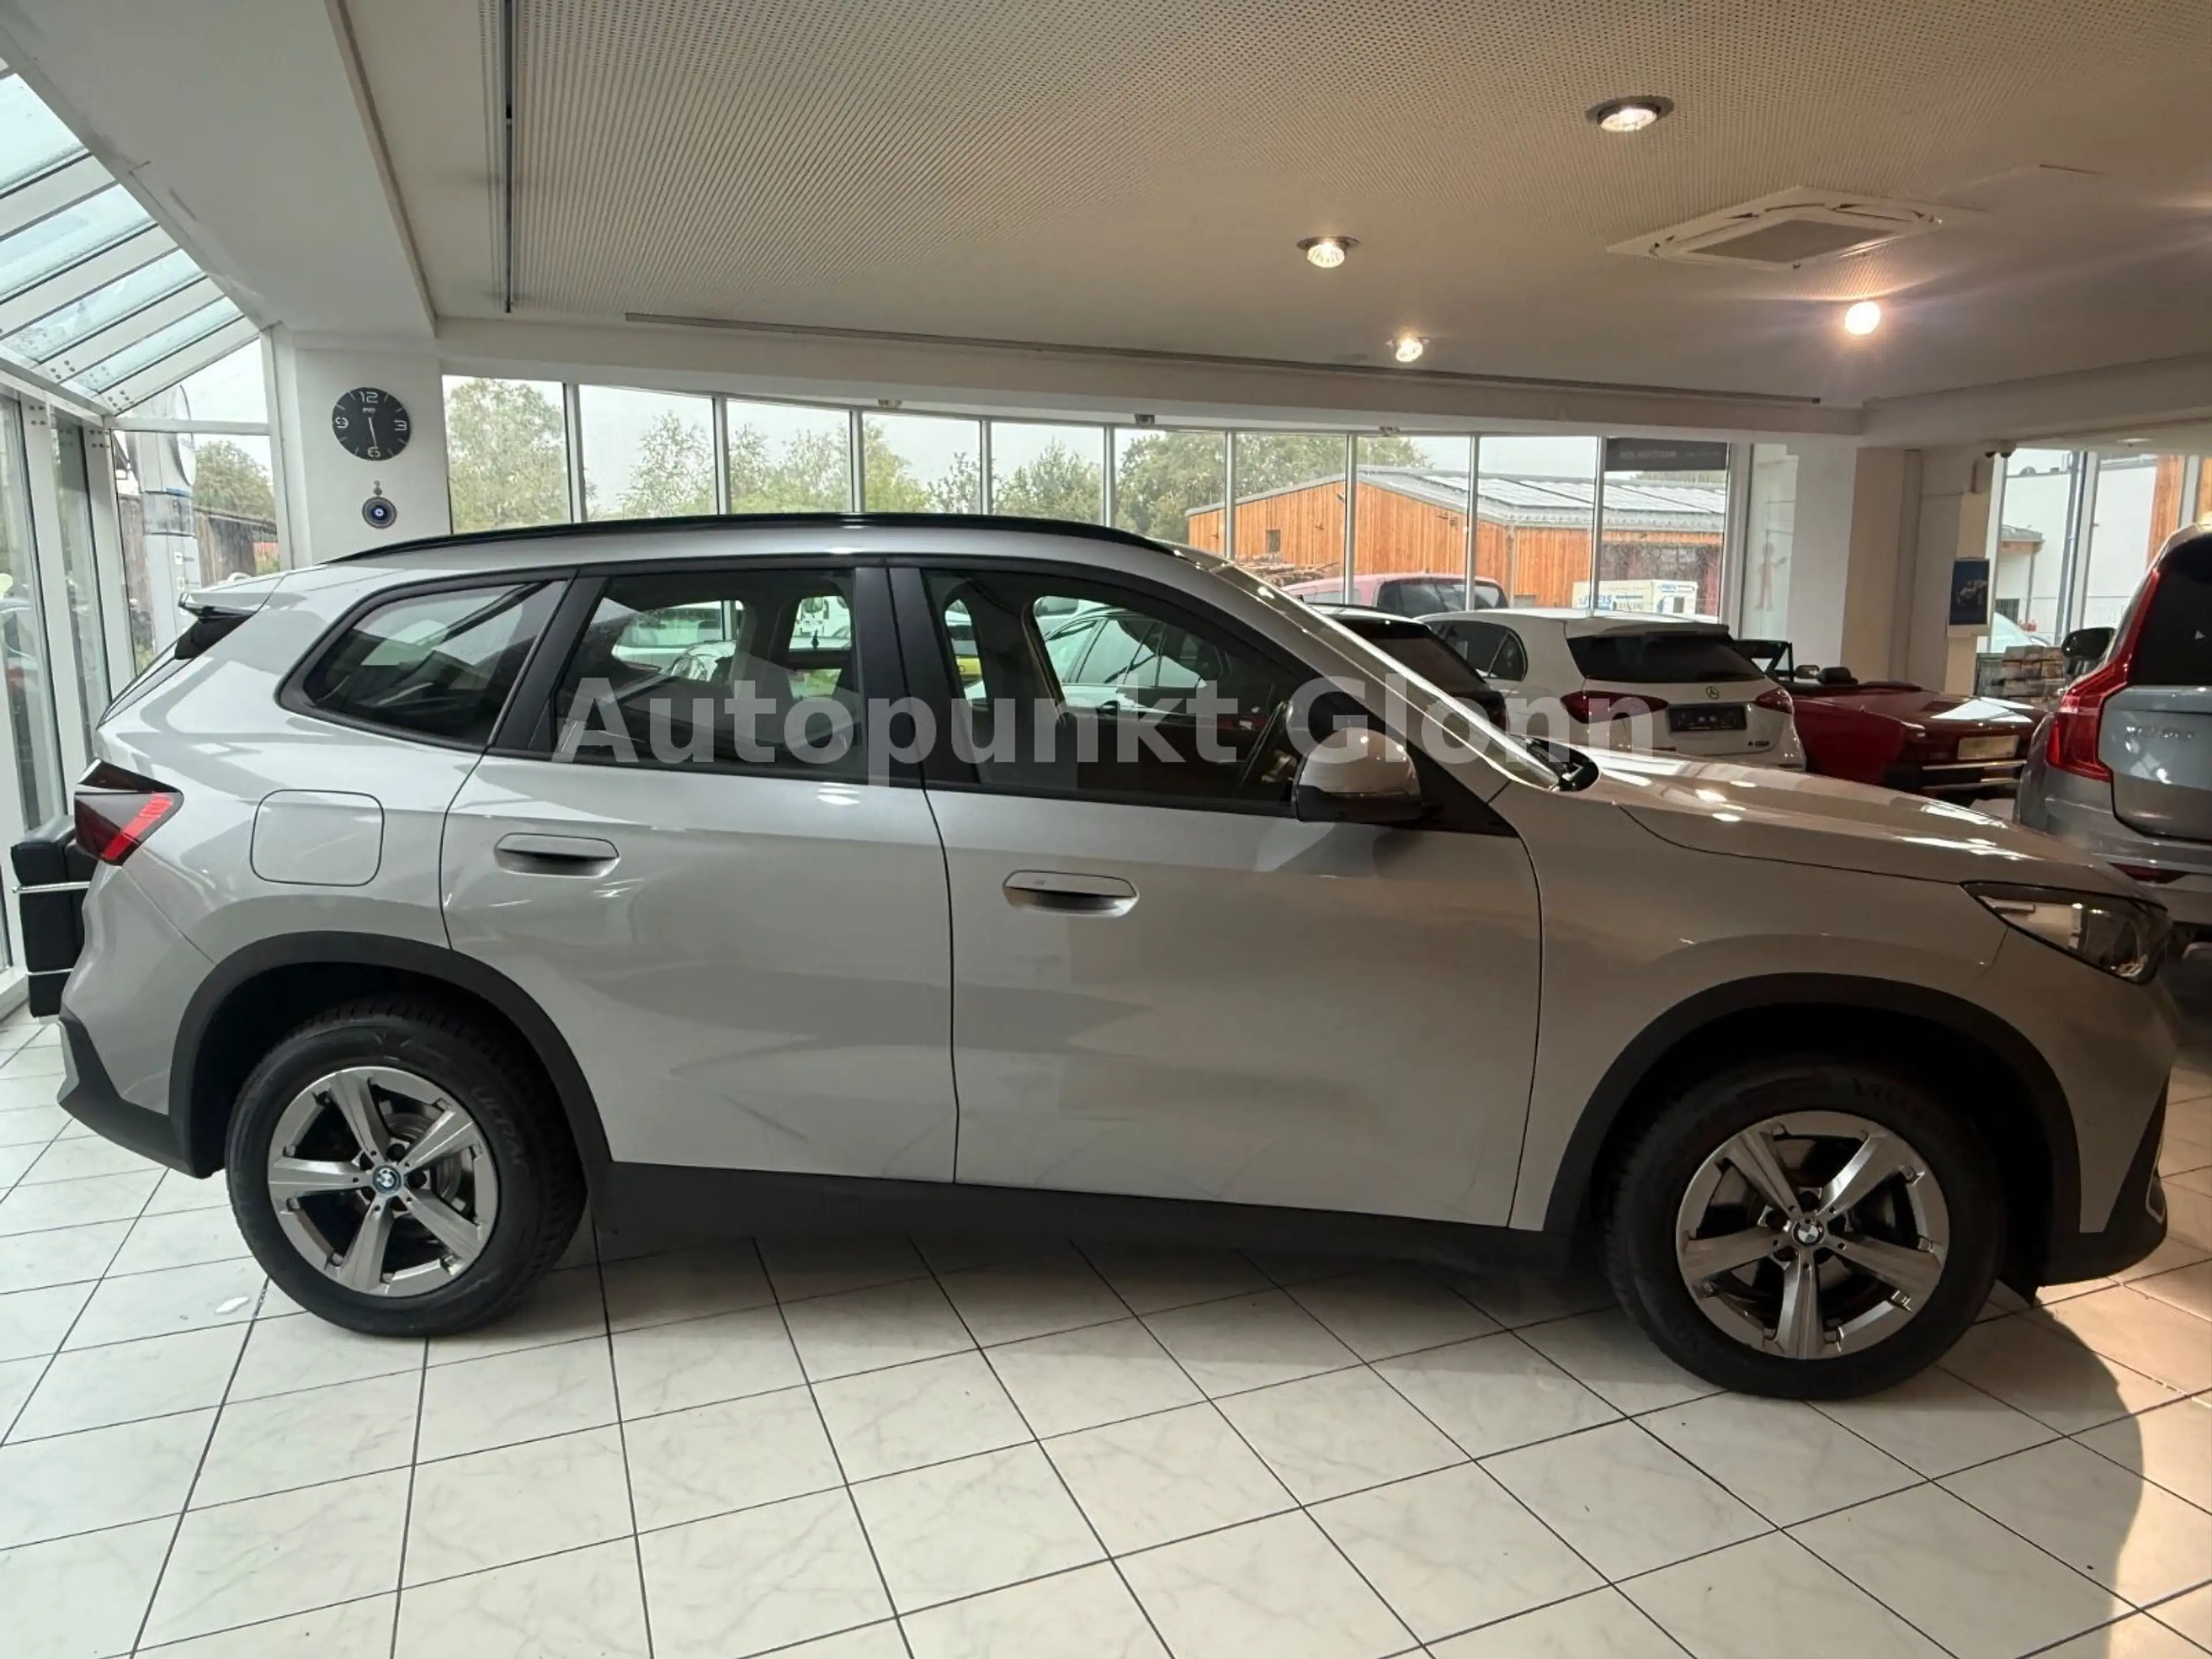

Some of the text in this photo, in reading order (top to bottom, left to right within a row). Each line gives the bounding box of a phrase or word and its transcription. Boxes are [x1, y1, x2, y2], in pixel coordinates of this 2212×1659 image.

[359, 392, 378, 404] 12
[394, 420, 407, 431] 3
[368, 446, 381, 457] 6
